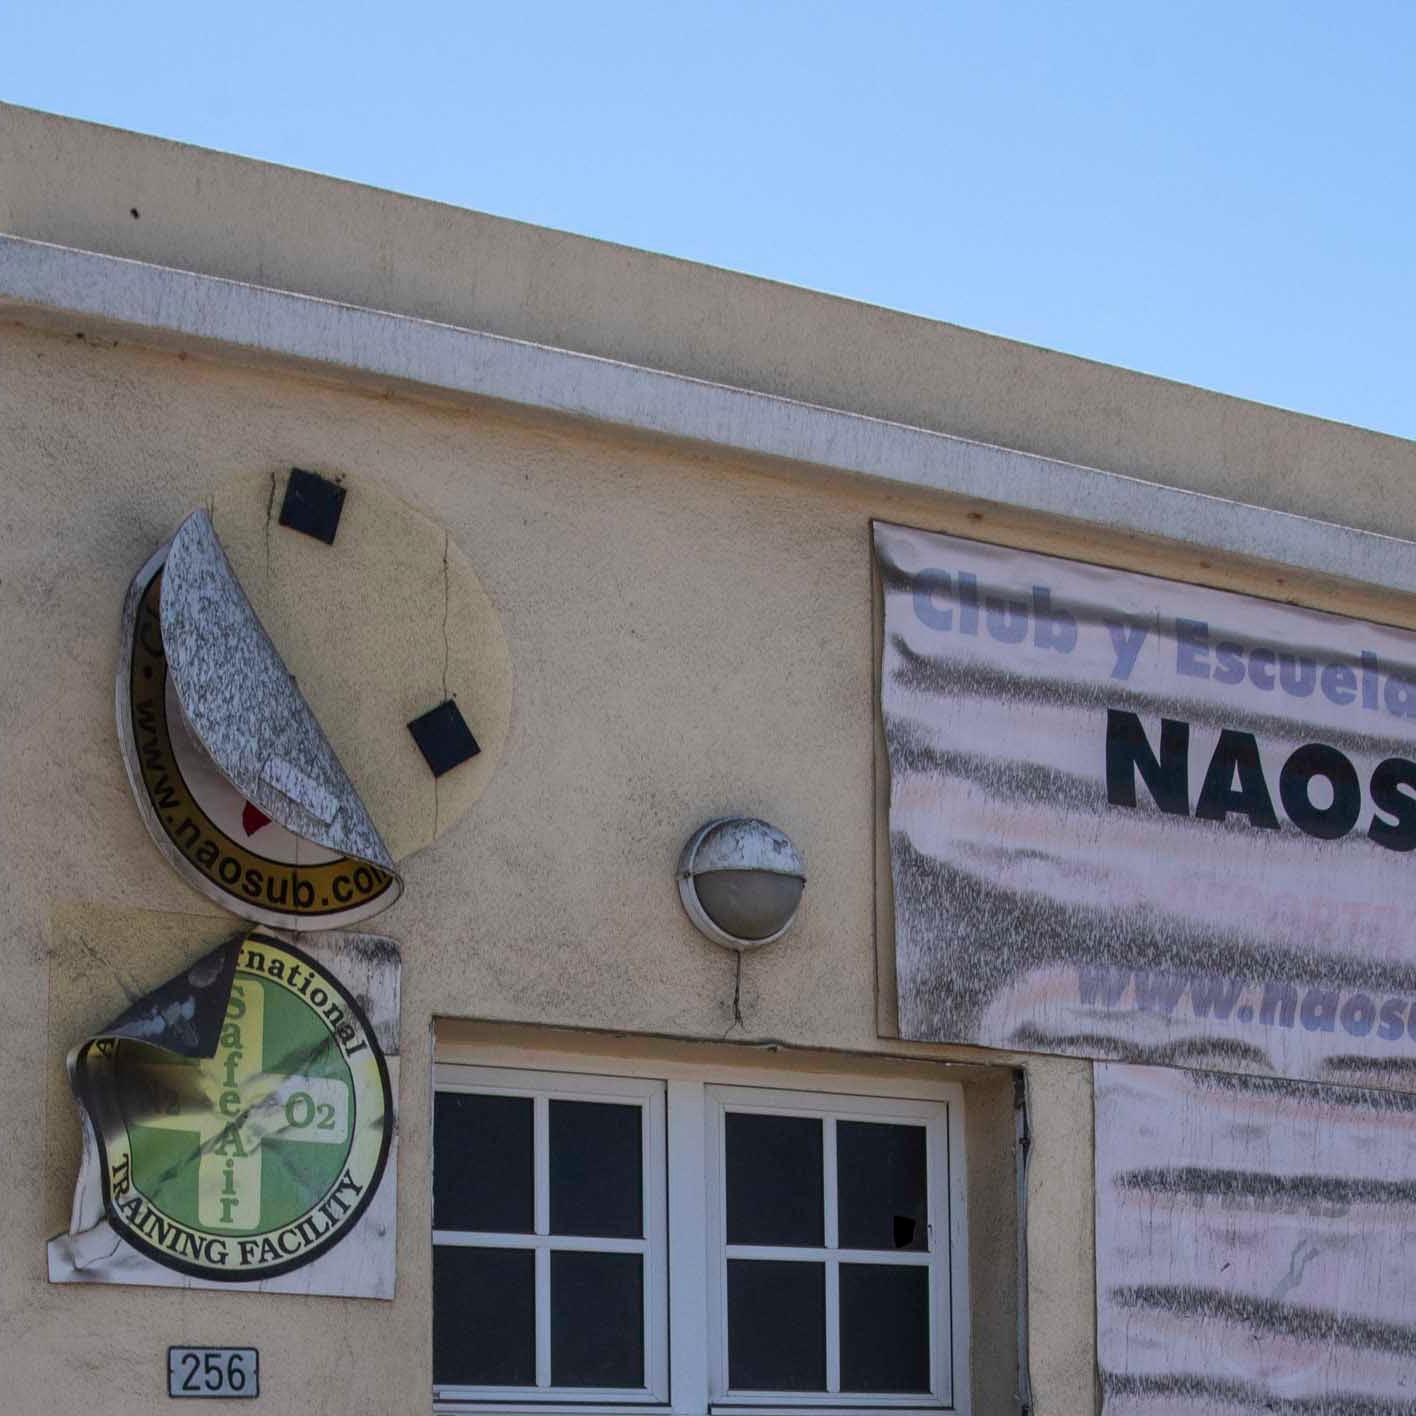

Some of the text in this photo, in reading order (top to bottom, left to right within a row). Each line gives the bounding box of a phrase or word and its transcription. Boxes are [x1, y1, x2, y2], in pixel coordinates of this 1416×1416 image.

[912, 566, 1078, 654] Club
[1103, 613, 1151, 682] y
[111, 1153, 364, 1266] TRAINING FACILITY
[181, 1353, 245, 1391] 256
